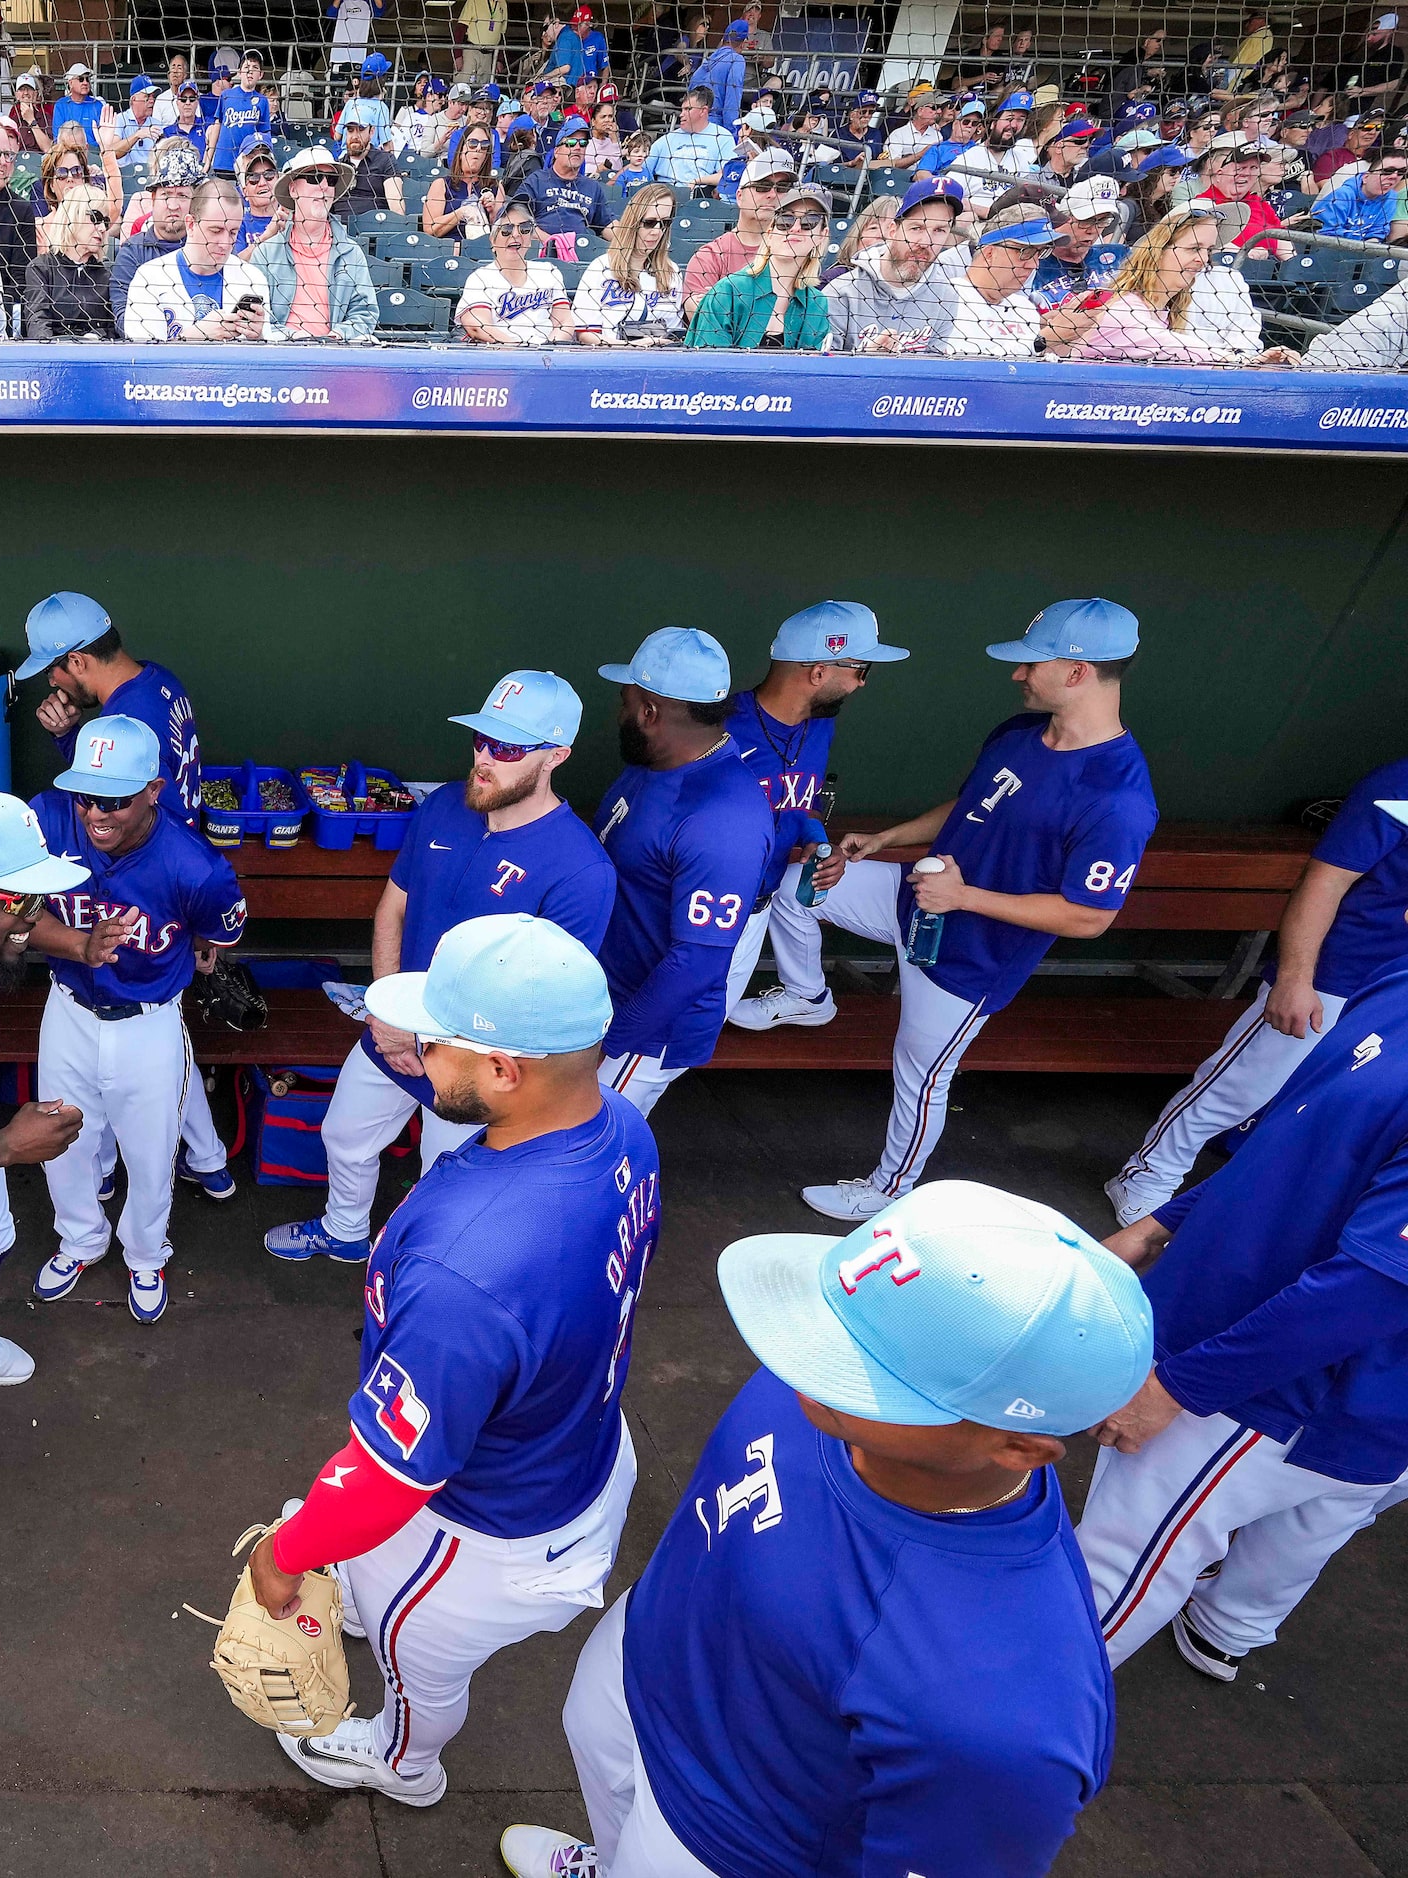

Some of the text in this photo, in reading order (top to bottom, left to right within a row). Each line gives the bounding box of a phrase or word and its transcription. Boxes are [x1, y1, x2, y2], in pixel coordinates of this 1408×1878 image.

[224, 105, 260, 128] Royals
[1143, 107, 1153, 116] T
[546, 135, 554, 145] T
[932, 177, 951, 194] T
[1043, 269, 1118, 295] TEAS
[123, 380, 329, 407] texasrangers.com
[411, 386, 509, 408] @RANGERS
[591, 389, 792, 416] texasrangers.com
[872, 396, 968, 417] @RANGERS
[1044, 398, 1242, 426] texasrangers.com
[493, 679, 523, 710] T
[90, 736, 114, 768] T
[981, 766, 1023, 812] T
[21, 809, 47, 848] T
[207, 822, 241, 835] GIANTS
[601, 796, 630, 844] T
[490, 858, 527, 897] T
[1085, 860, 1137, 895] 84
[687, 889, 742, 931] 63
[606, 1170, 657, 1296] ORTIZ
[838, 1216, 921, 1296] T
[715, 1432, 784, 1536] T
